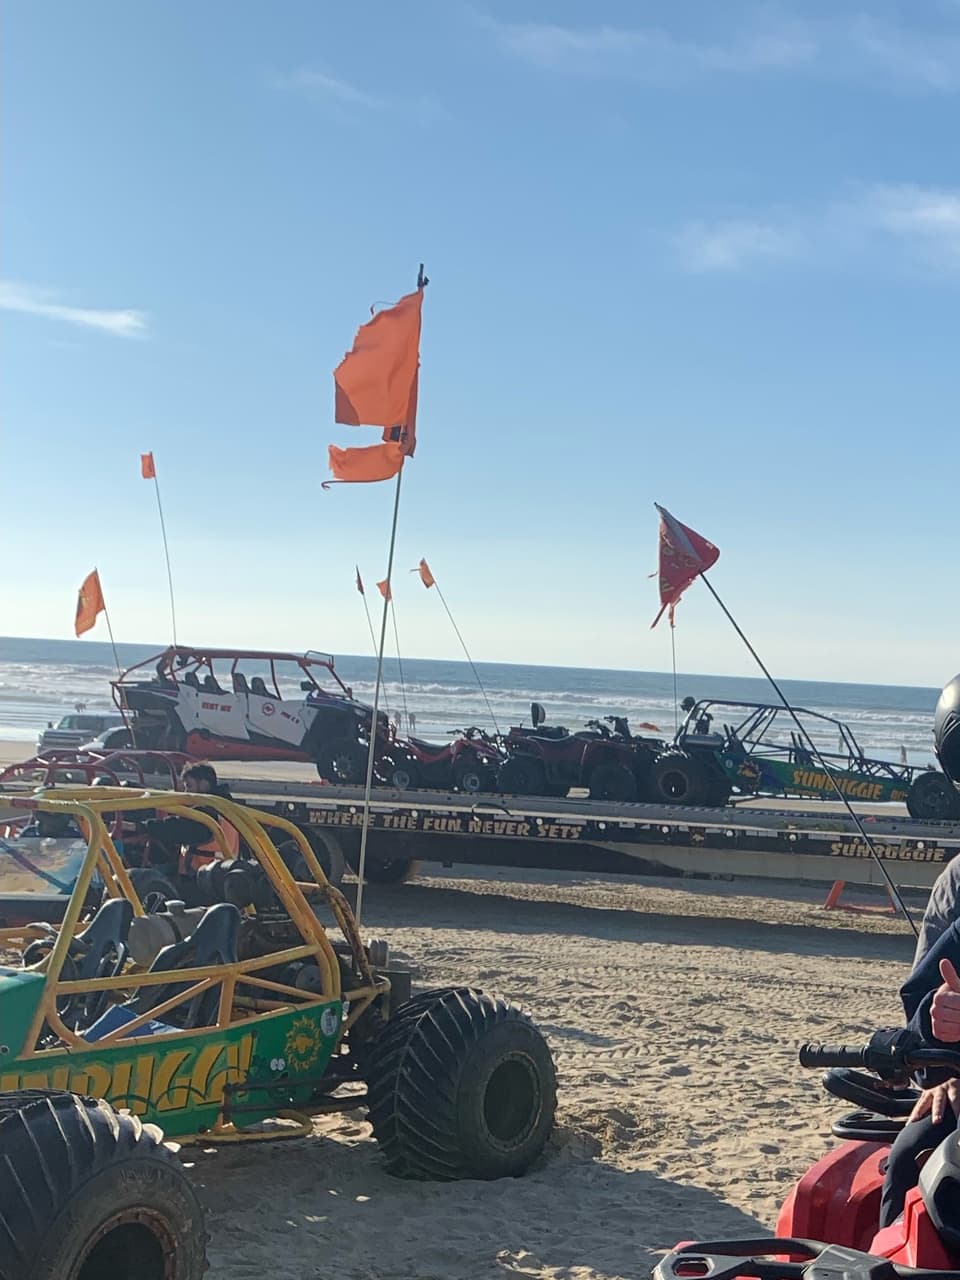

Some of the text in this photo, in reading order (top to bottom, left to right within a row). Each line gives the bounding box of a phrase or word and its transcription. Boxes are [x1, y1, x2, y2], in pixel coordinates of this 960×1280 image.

[309, 811, 583, 839] WHERE THE FUN NEVER SETS
